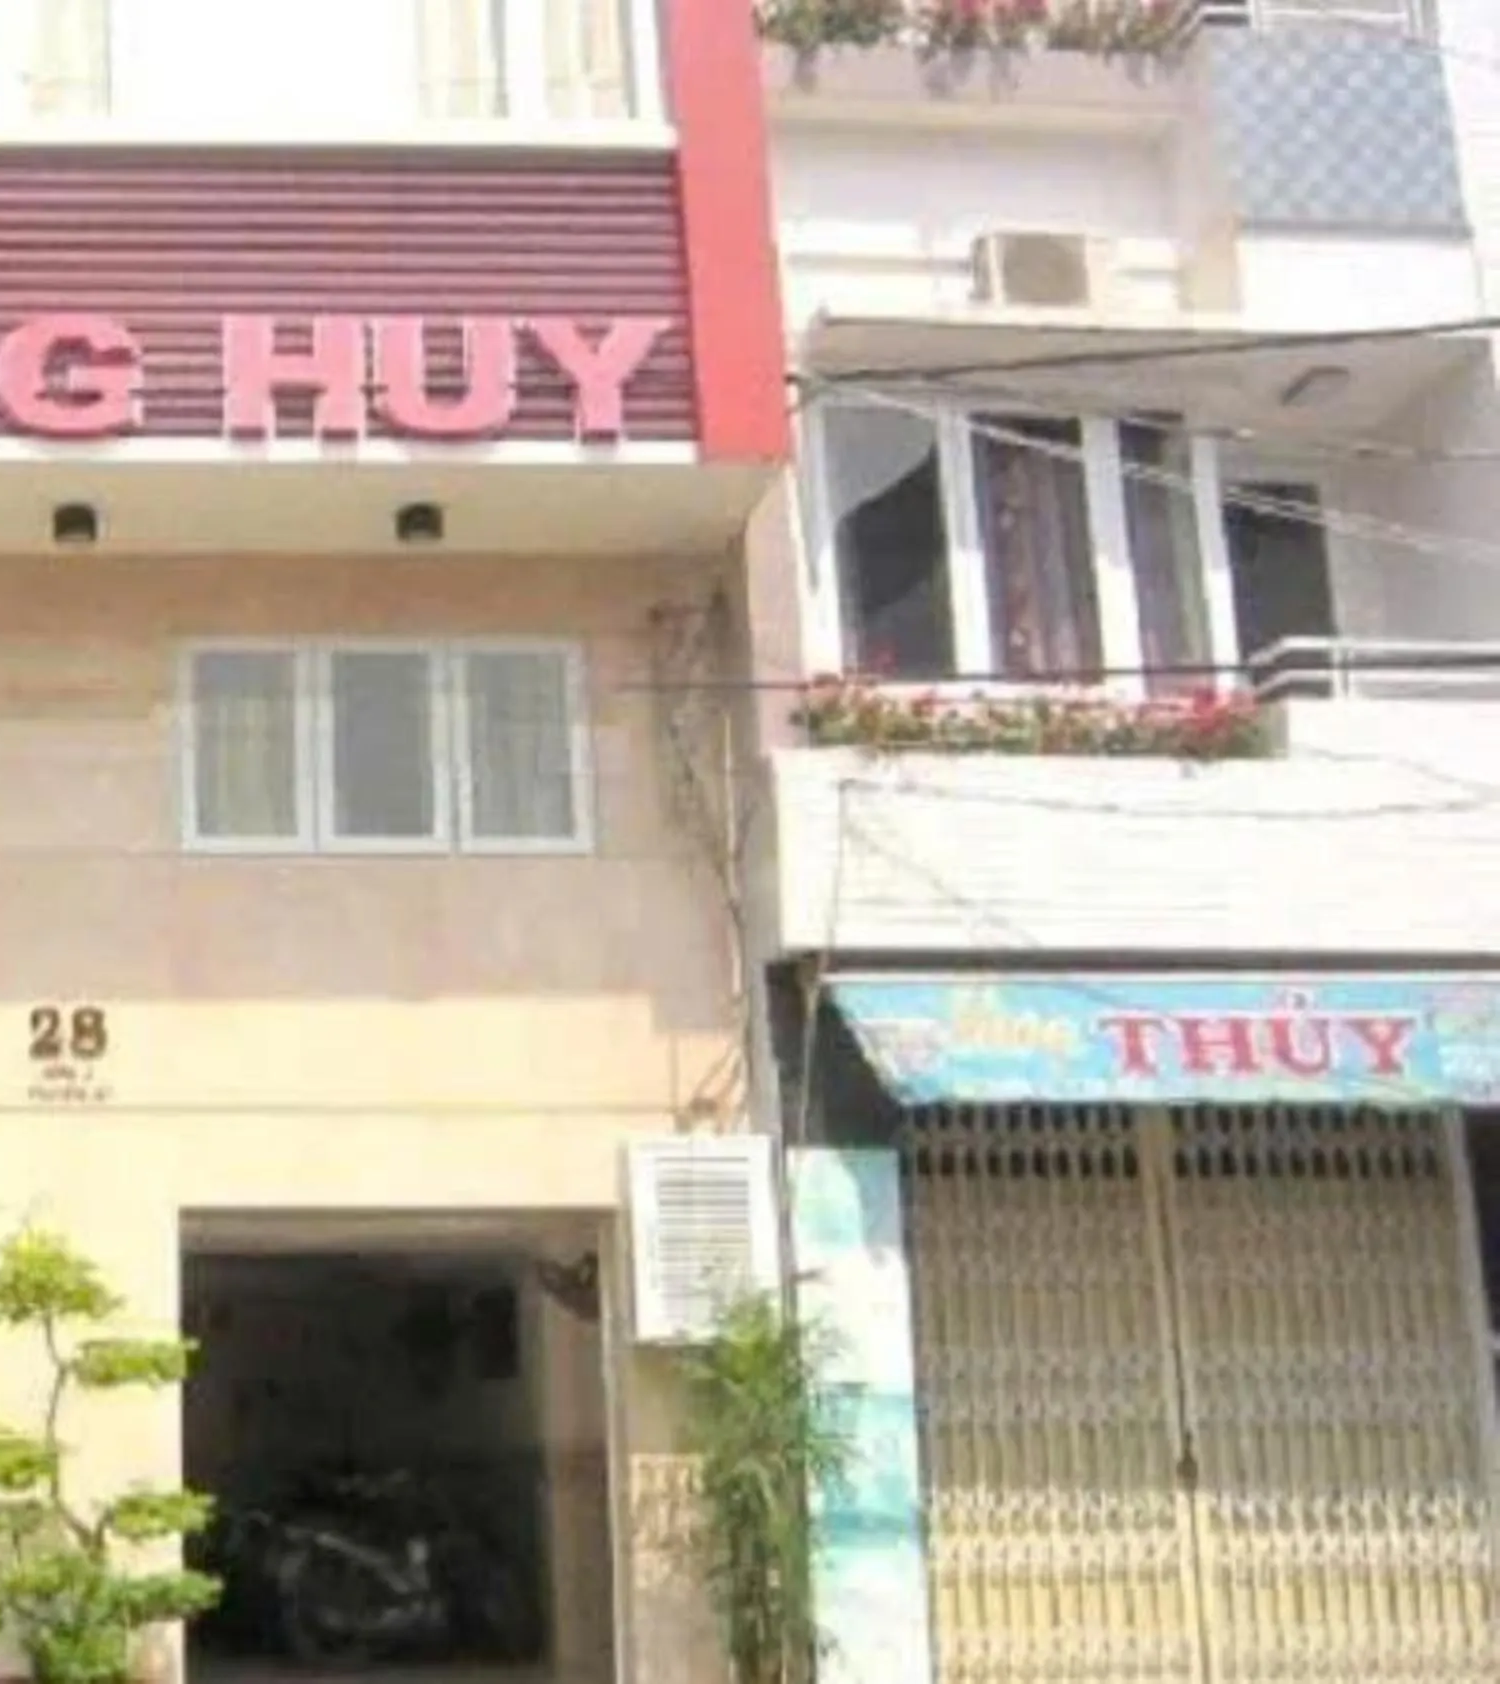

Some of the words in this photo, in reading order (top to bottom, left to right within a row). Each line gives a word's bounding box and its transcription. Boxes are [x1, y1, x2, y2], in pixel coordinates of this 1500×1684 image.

[220, 312, 668, 442] HUY
[28, 1005, 107, 1060] 28
[1098, 992, 1414, 1077] THỦY
